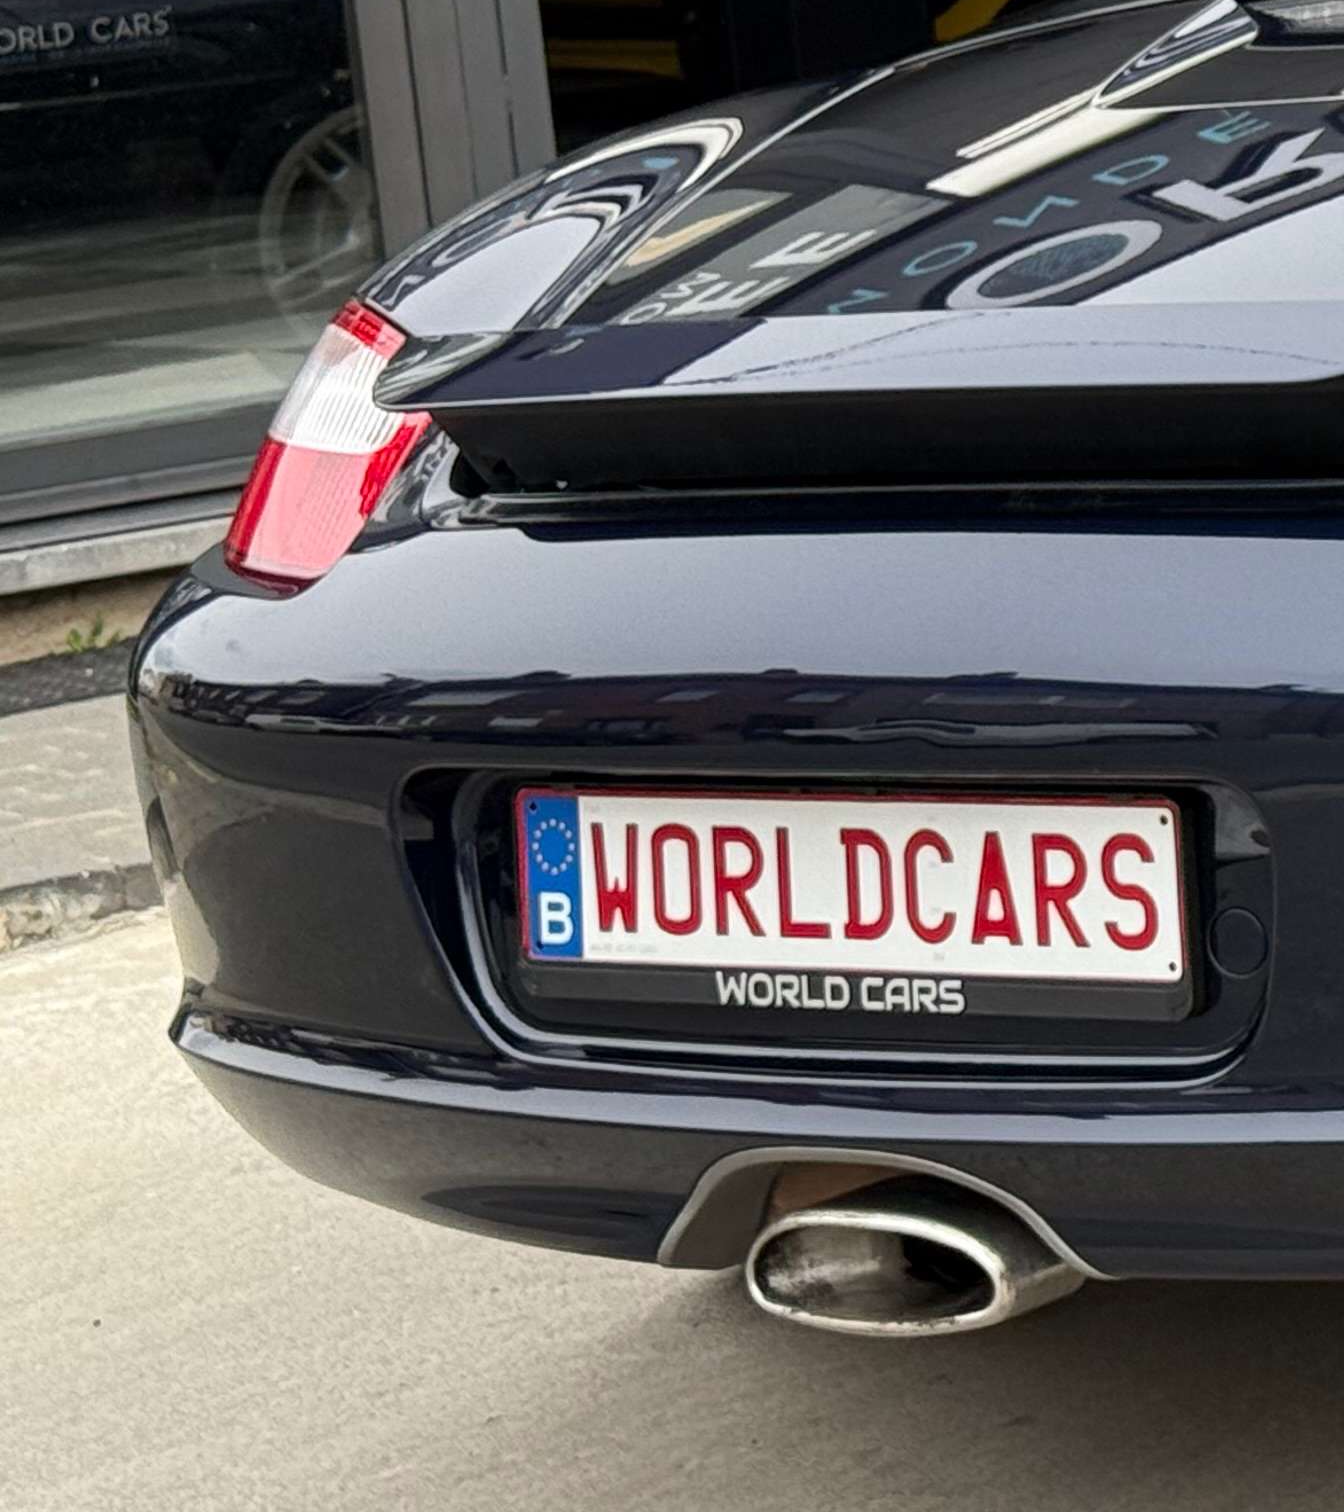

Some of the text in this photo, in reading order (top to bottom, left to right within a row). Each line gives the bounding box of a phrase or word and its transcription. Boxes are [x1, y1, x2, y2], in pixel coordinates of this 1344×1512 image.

[0, 21, 75, 56] ORLD
[590, 821, 1159, 951] WORLDCARS
[539, 891, 574, 945] B
[715, 971, 966, 1014] WORLD CARS
